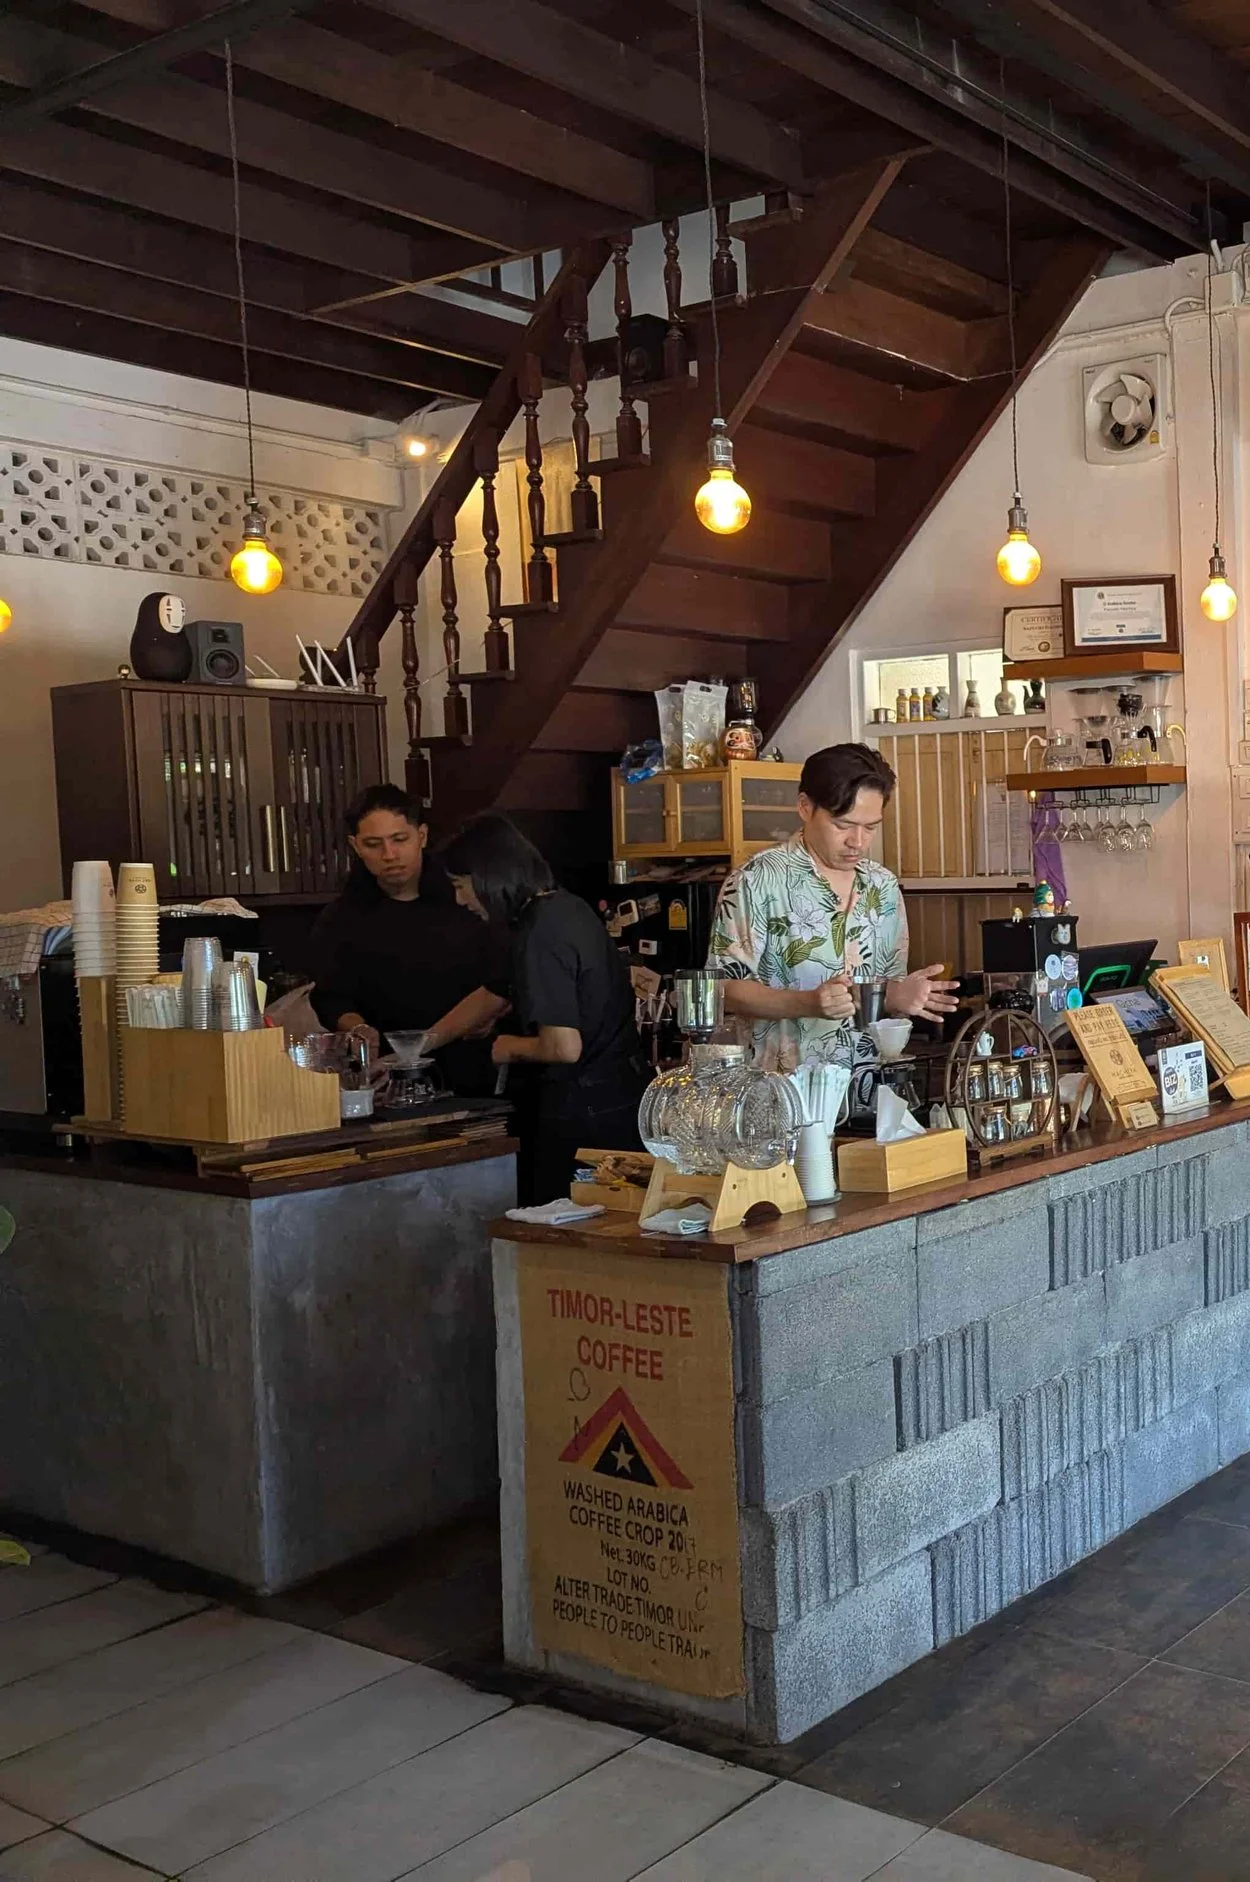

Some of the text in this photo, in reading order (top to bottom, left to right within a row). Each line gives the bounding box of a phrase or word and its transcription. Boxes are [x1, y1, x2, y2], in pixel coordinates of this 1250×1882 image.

[546, 1288, 694, 1338] TIMOR-LESTE
[577, 1335, 665, 1381] COFFEE
[563, 1479, 689, 1527] WASHED ARABICA
[569, 1504, 622, 1538] COFFEE
[624, 1520, 664, 1547] CROP
[606, 1566, 652, 1595] LOT NO.
[626, 1548, 656, 1572] 30KG
[553, 1598, 598, 1629] PEOPLE
[600, 1611, 618, 1635] TO
[621, 1619, 666, 1651] PEOPLE
[554, 1575, 591, 1601] ALTER
[591, 1583, 633, 1615] TRADE
[634, 1597, 675, 1627] TIMOR
